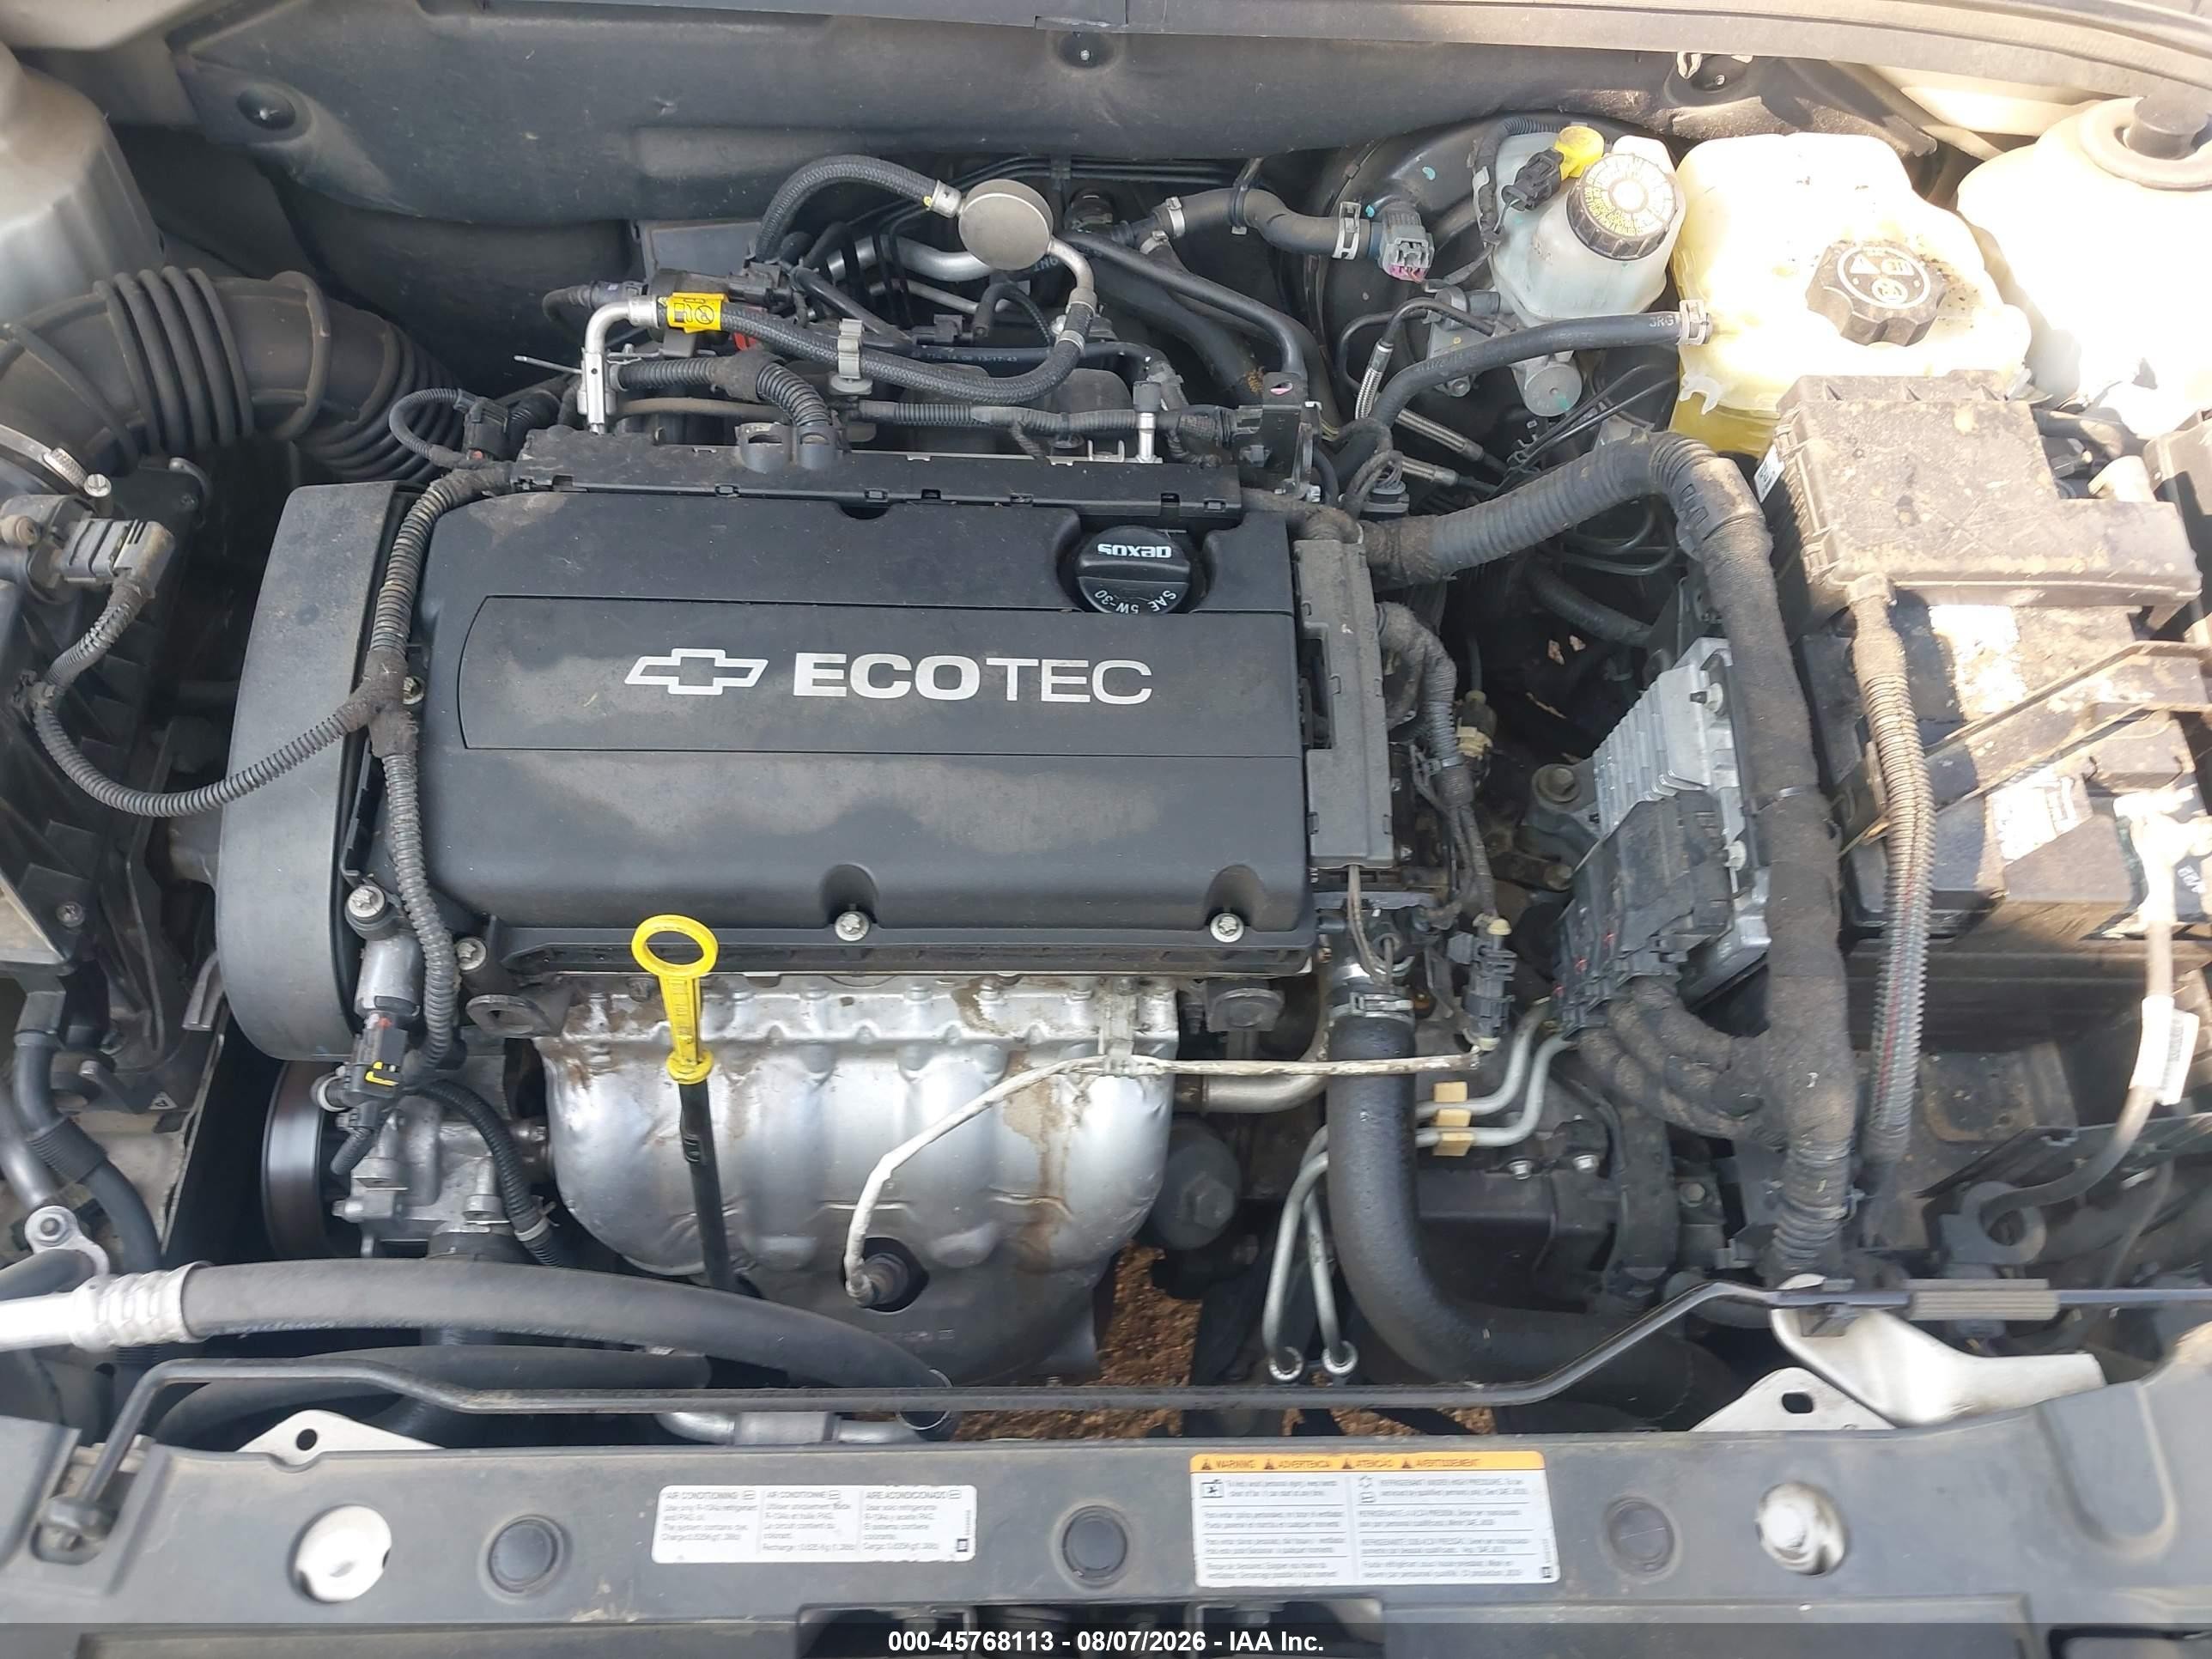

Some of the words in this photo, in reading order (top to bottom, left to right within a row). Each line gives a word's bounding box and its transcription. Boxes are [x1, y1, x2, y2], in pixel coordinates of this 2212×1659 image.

[1095, 590, 1139, 614] 5W-30
[1147, 590, 1176, 612] SAE
[793, 652, 1152, 706] ECOTEC
